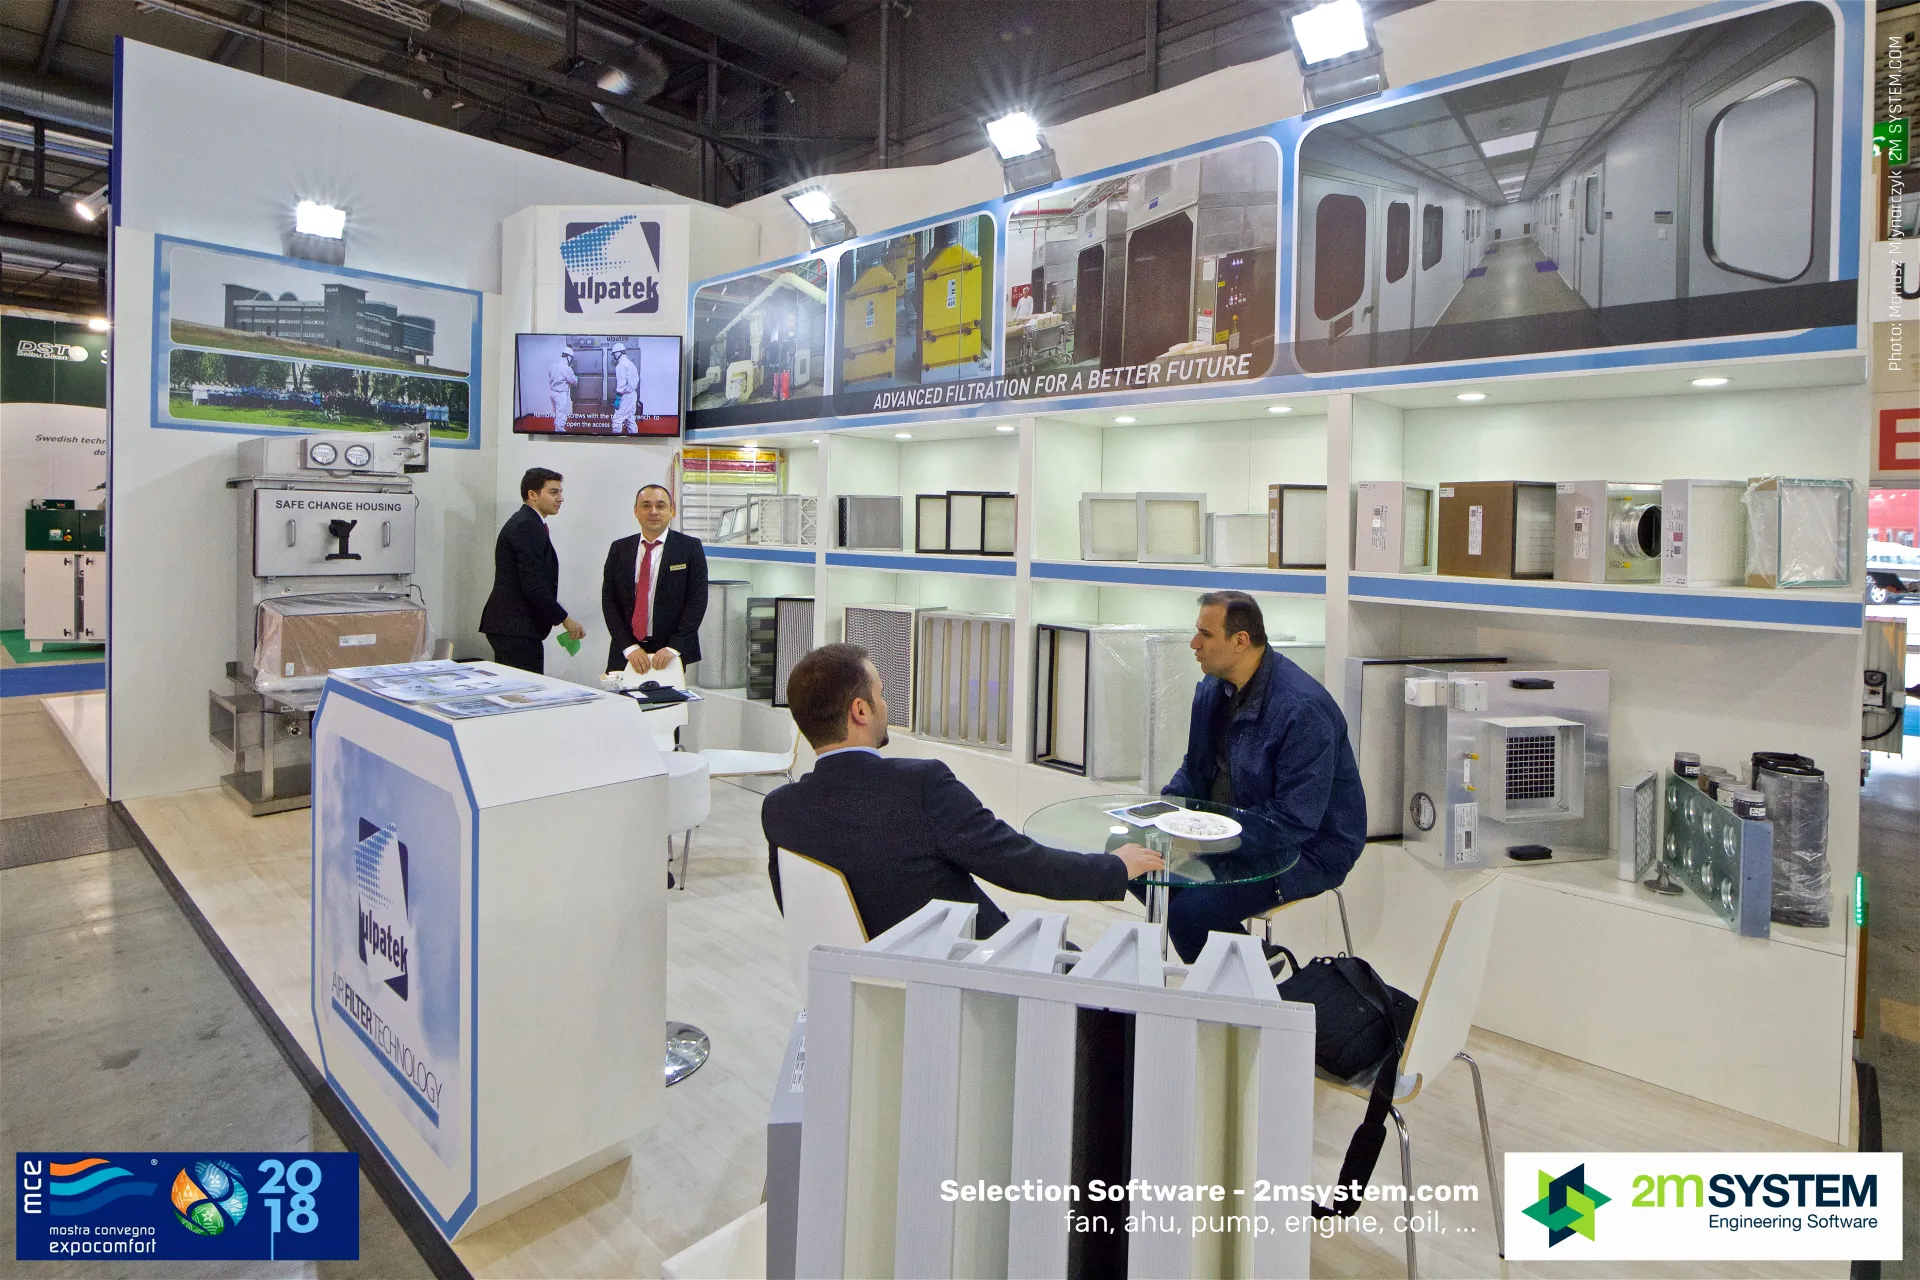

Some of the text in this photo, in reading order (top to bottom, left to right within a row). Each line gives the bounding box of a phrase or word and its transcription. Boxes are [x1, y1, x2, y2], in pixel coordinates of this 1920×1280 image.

[572, 276, 659, 304] ulpatek
[18, 340, 70, 355] DST
[873, 353, 1252, 410] ADVANCED FILTRATION FOR A BETTER FUTURE
[35, 434, 78, 444] Swedish
[275, 500, 402, 511] SAFE CHANGE HOUSING
[362, 909, 408, 975] ulpatek
